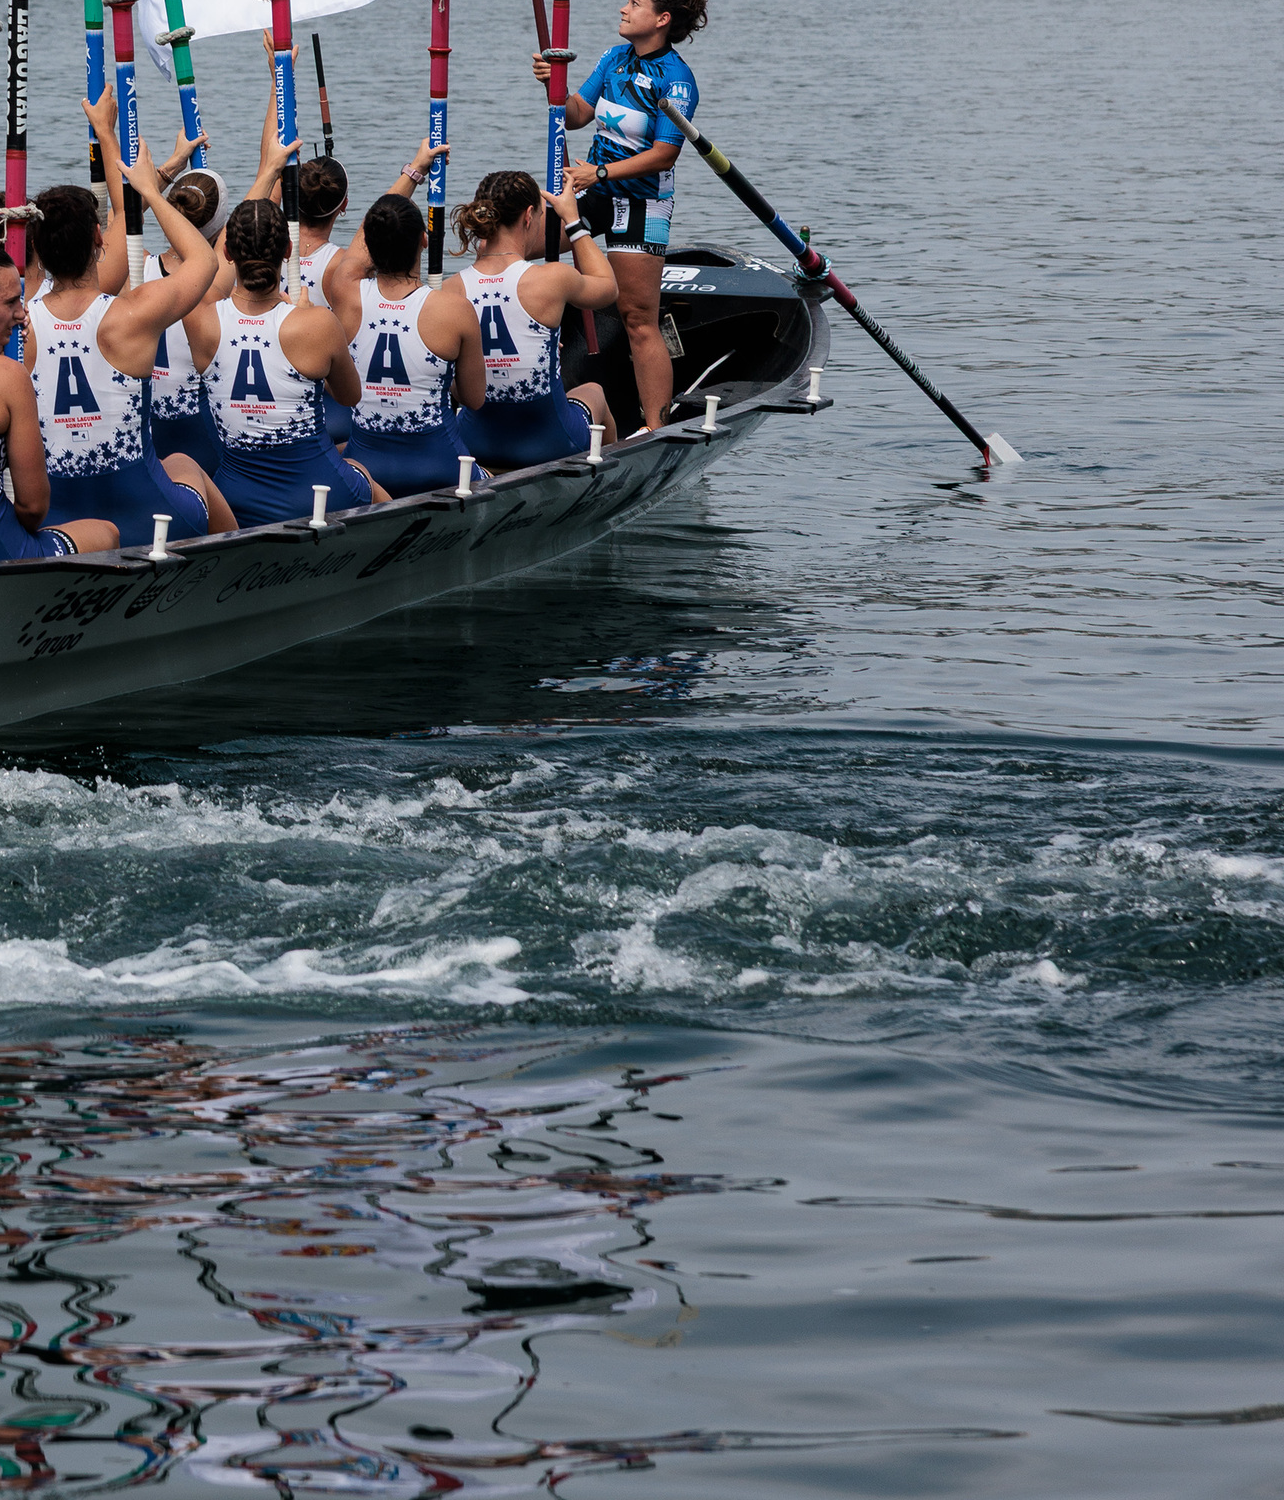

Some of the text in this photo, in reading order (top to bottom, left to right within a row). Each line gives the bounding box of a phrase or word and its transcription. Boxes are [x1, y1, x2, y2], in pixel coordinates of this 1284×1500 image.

[552, 134, 565, 196] CaixaBank
[53, 323, 82, 331] amura
[378, 302, 406, 310] amura
[855, 301, 889, 343] DONOSTIA
[246, 550, 356, 592] Goiko-Auto
[42, 581, 130, 627] asegi
[28, 632, 85, 662] grupo
